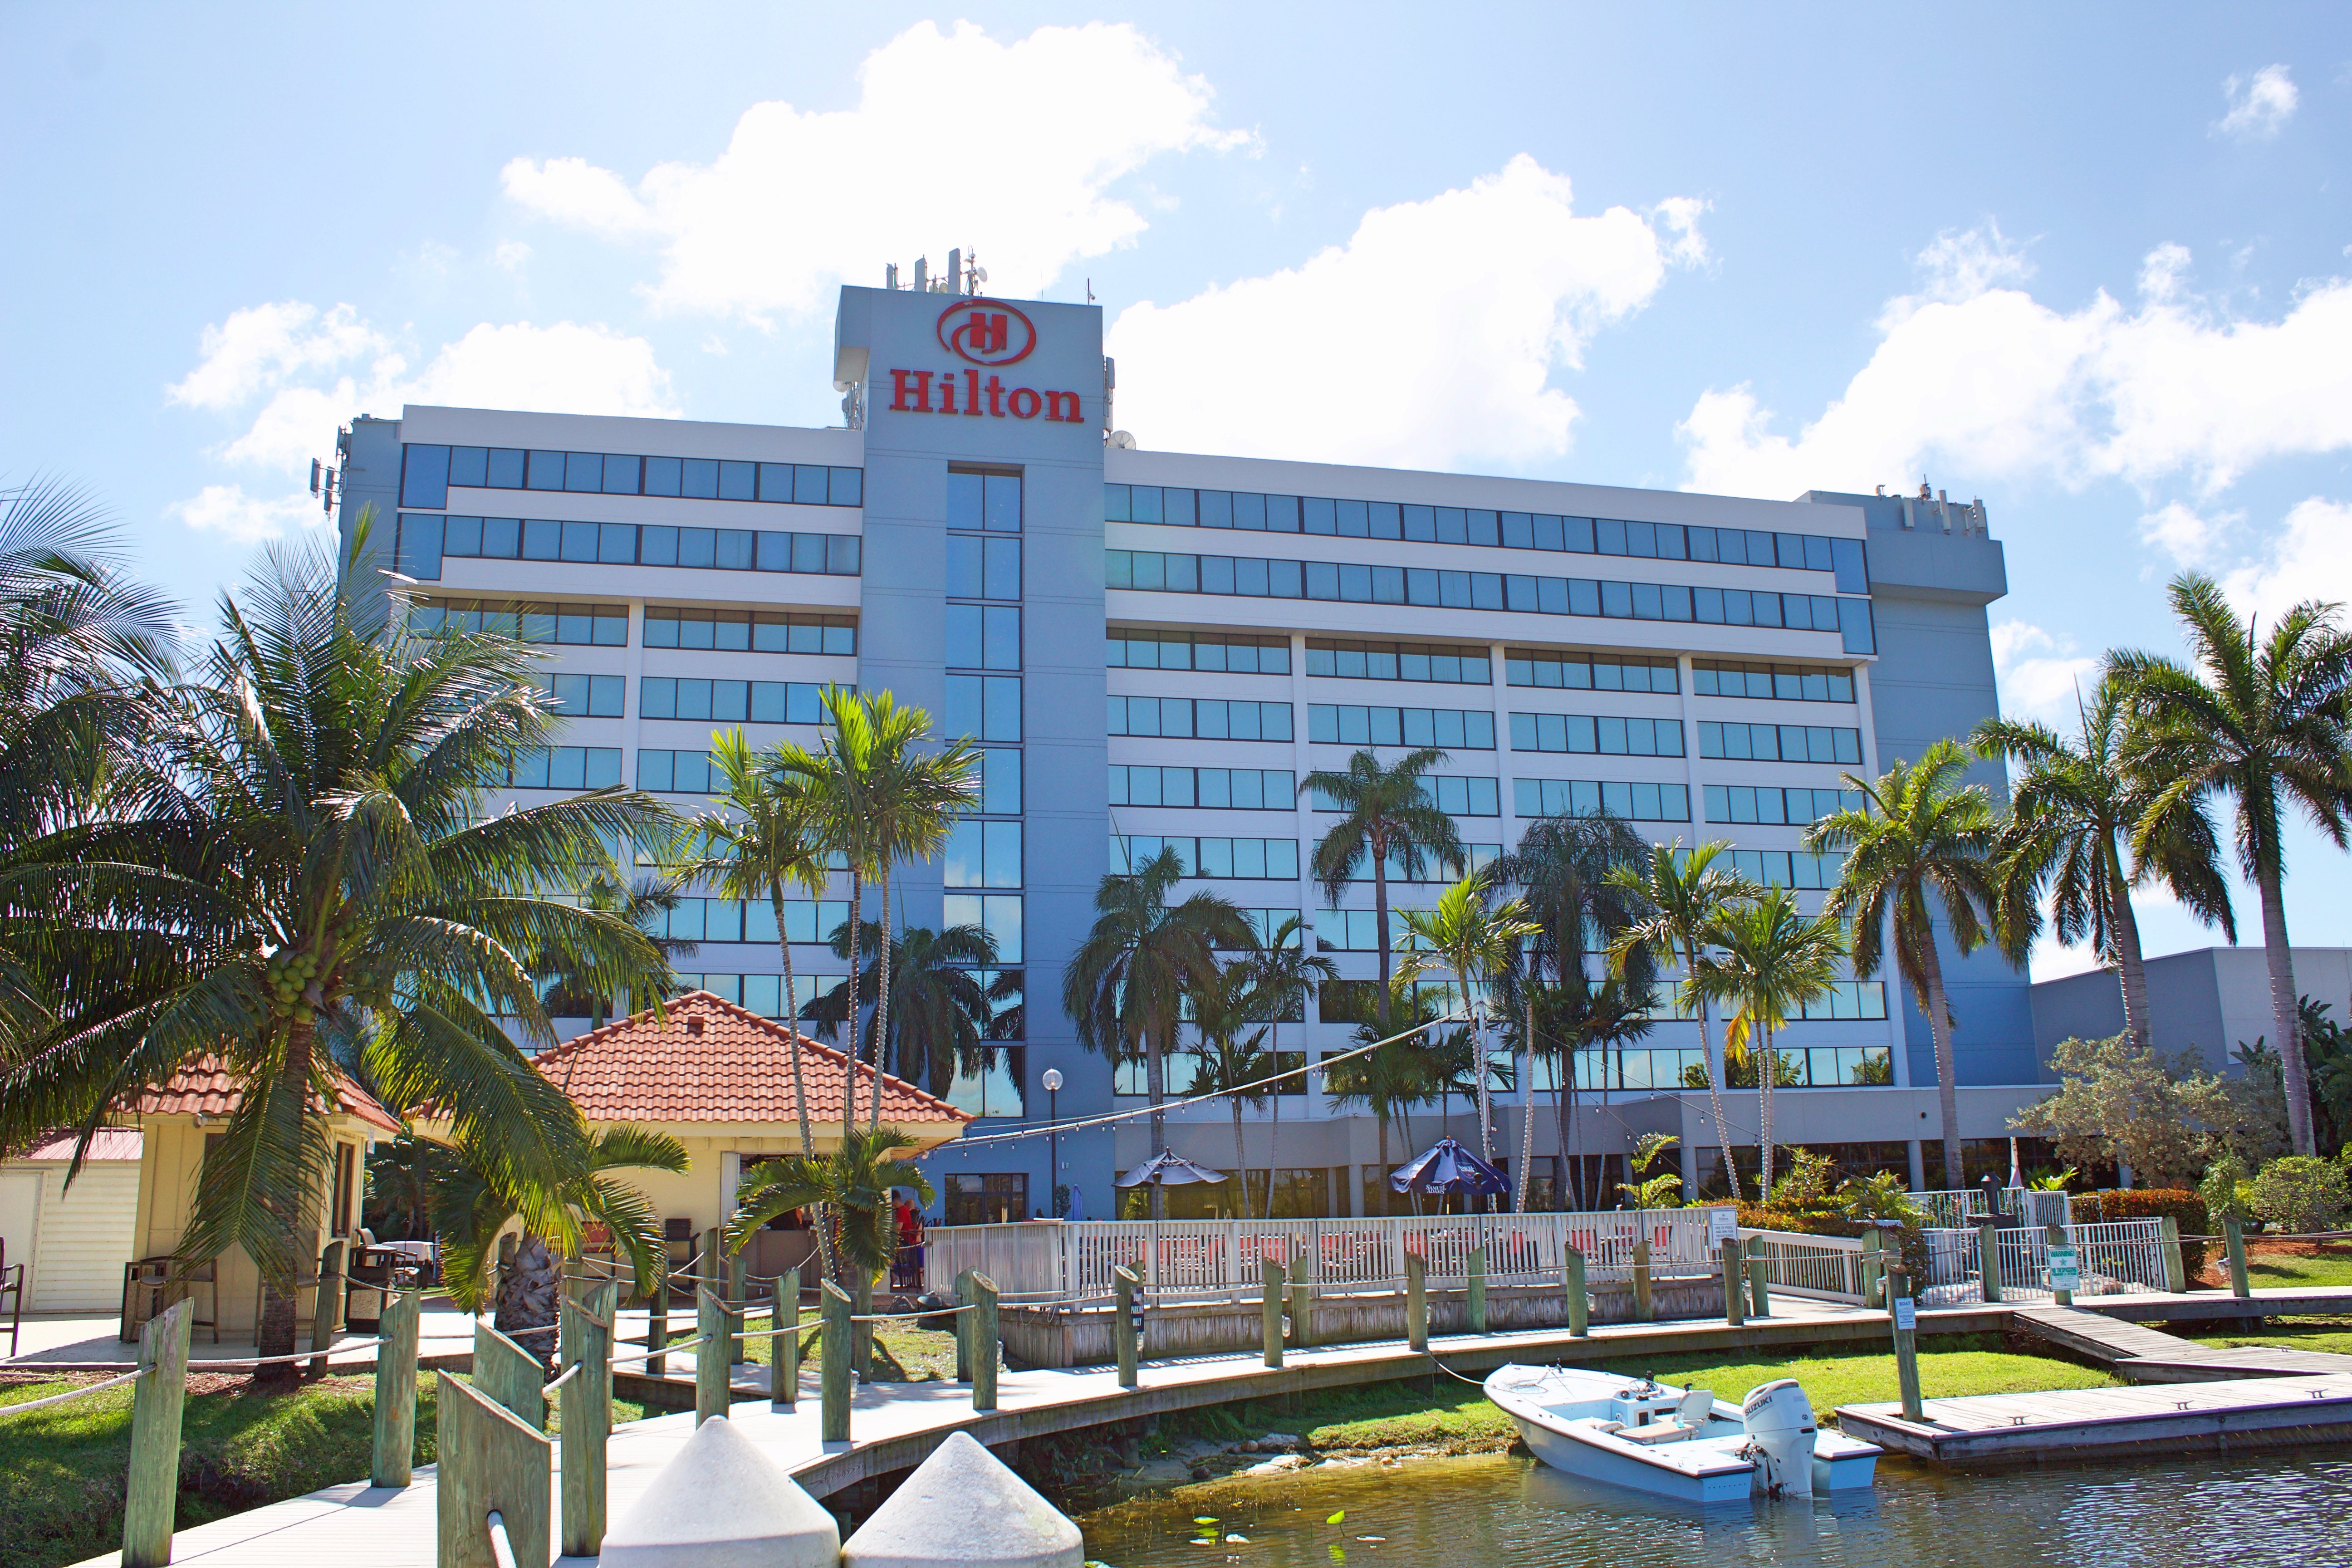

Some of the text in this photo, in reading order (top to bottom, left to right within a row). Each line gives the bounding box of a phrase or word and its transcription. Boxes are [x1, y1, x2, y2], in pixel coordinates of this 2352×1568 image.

[889, 369, 1084, 423] Hilton
[1133, 1293, 1142, 1302] BOAT
[1131, 1305, 1143, 1314] PARKING
[1132, 1318, 1142, 1326] ONLY
[1745, 1396, 1772, 1416] SUZUKI
